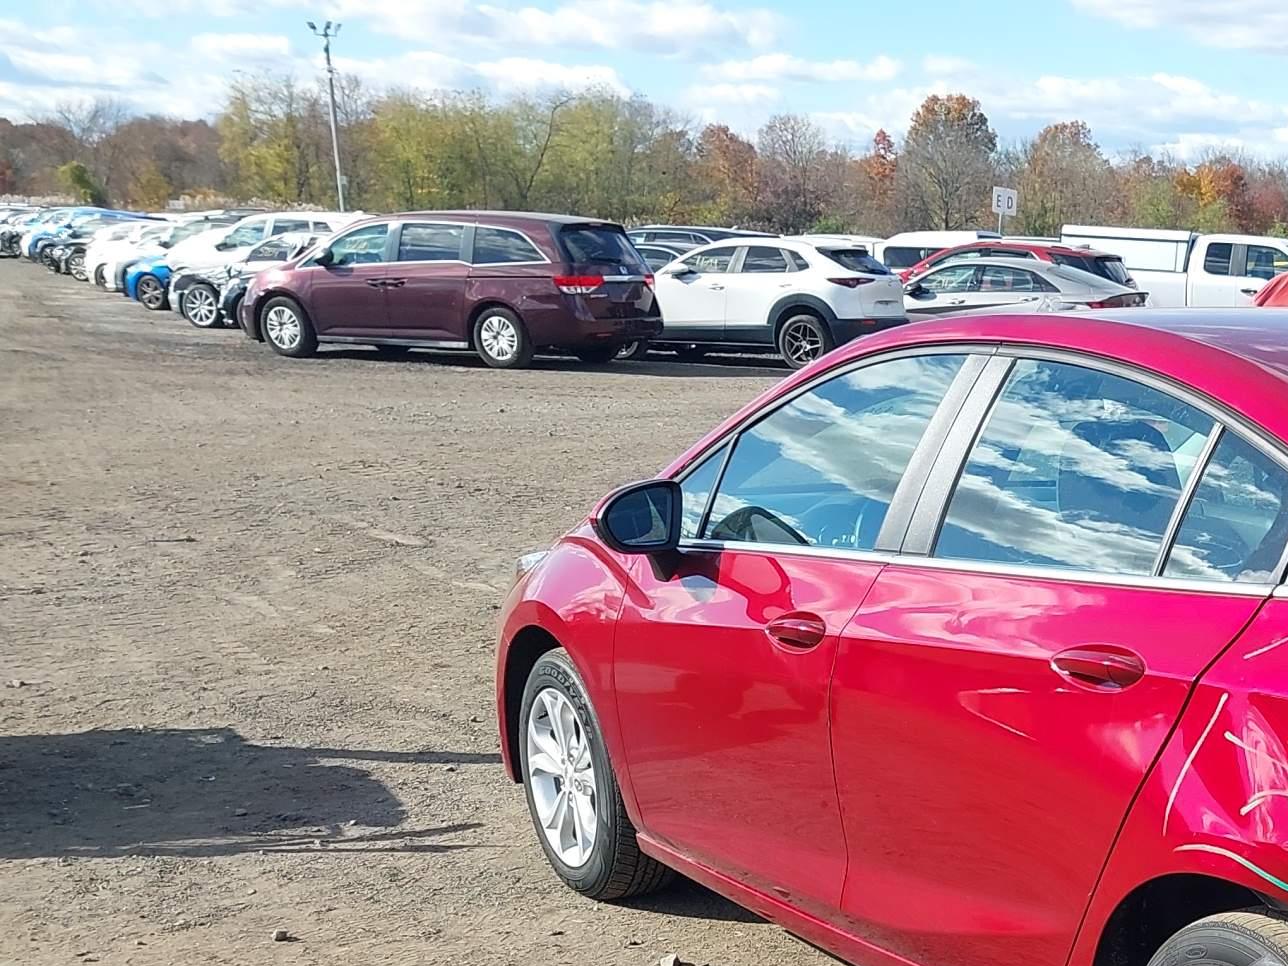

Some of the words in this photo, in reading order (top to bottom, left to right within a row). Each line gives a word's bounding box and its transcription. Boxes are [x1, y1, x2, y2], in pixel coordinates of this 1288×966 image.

[996, 194, 1002, 208] E
[1007, 196, 1013, 209] D
[539, 666, 593, 740] GOODYEAR
